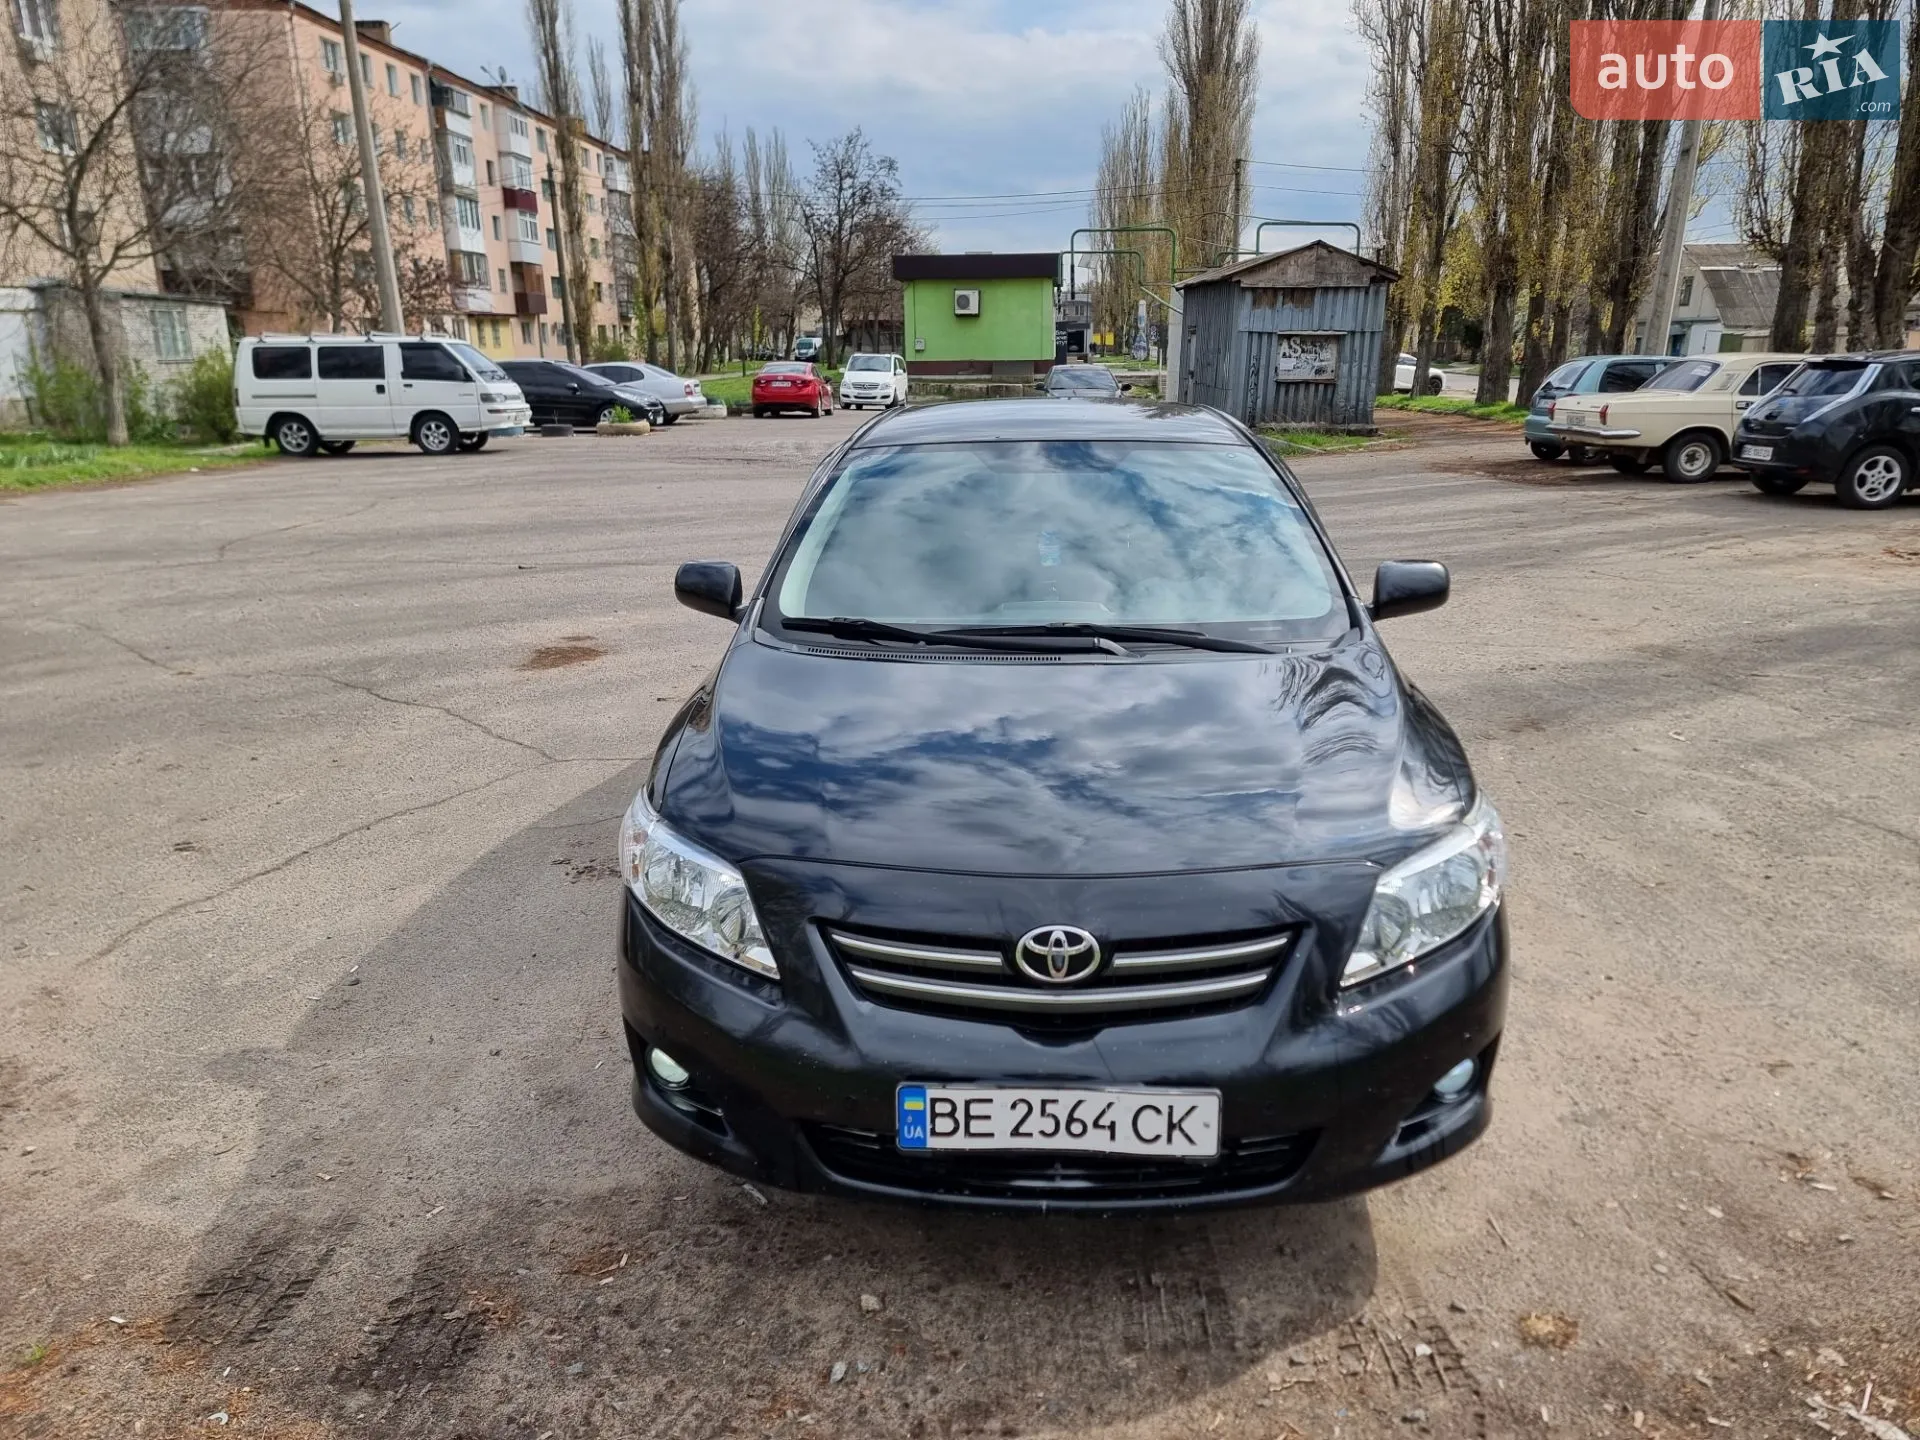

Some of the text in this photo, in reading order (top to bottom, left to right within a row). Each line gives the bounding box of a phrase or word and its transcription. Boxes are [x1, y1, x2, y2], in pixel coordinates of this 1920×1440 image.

[904, 1125, 924, 1139] UA
[929, 1097, 1199, 1146] BE 2564 CK
